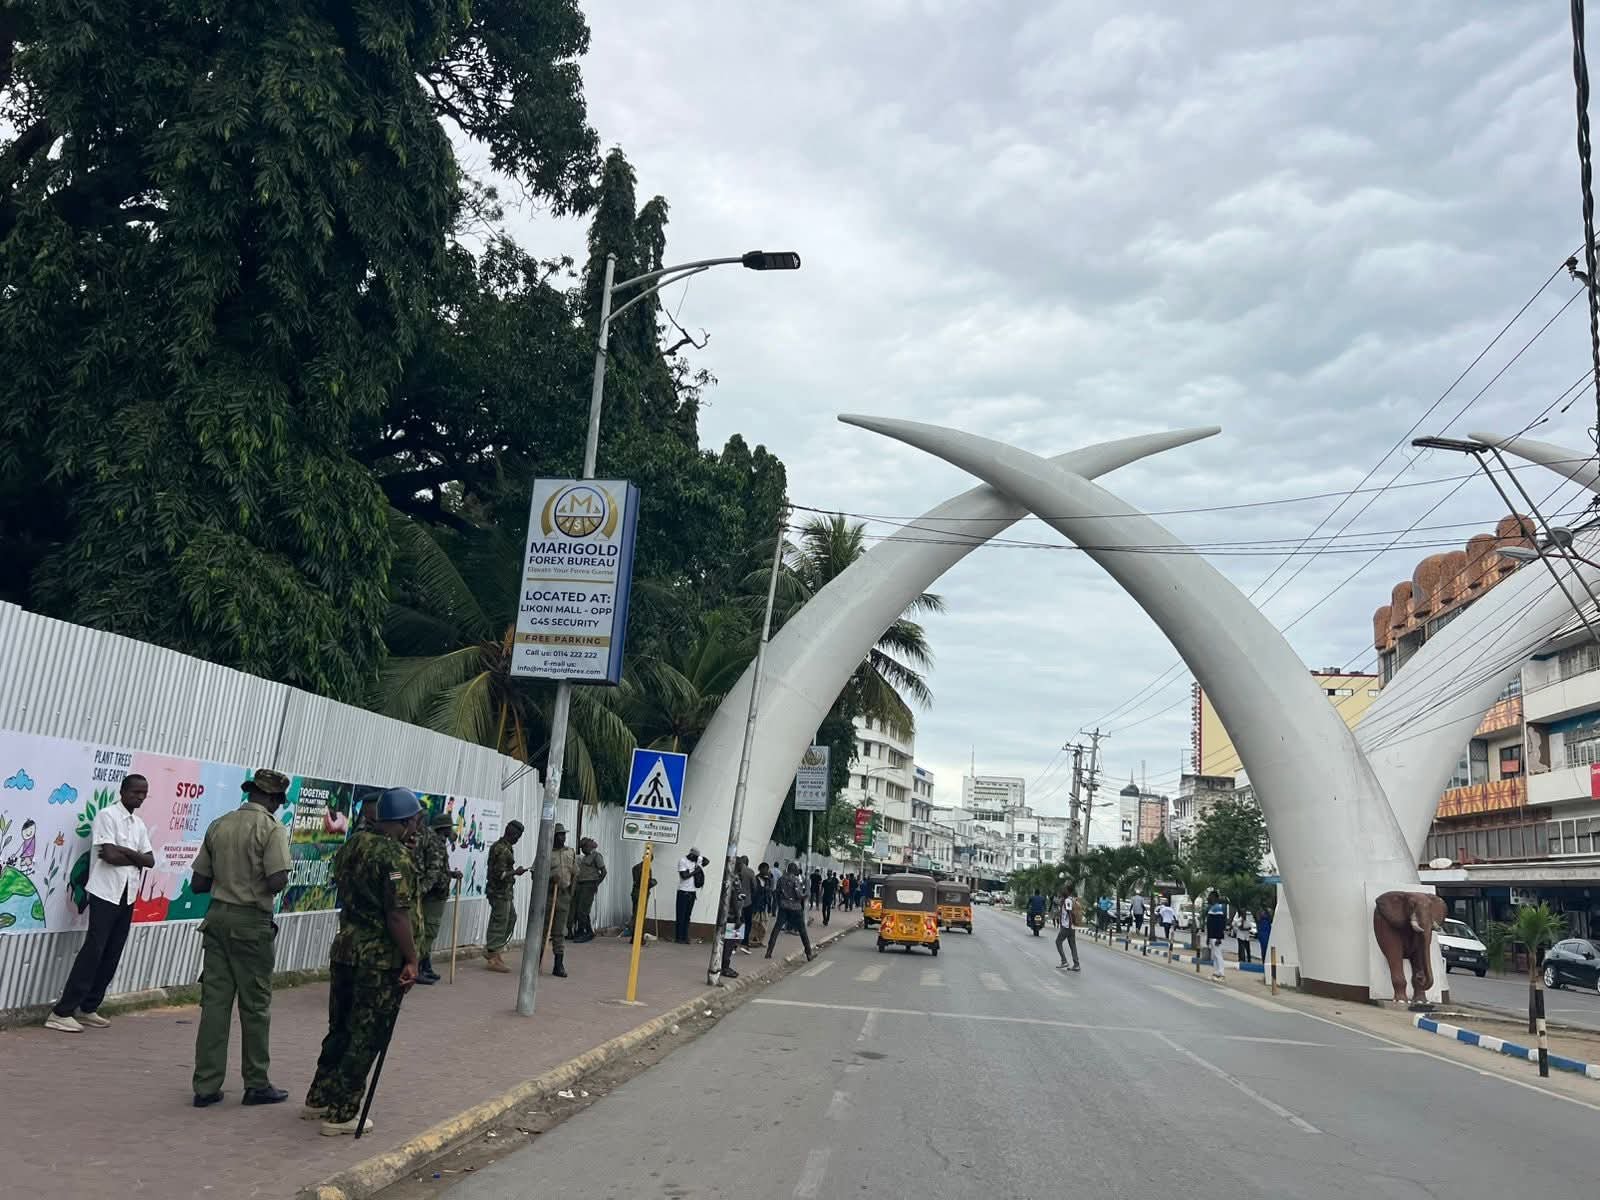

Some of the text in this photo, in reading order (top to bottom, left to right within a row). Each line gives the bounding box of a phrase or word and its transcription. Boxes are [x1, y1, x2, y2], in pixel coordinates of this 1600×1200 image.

[530, 542, 618, 556] MARIGOLD
[529, 556, 615, 567] FOREX BUREAU
[526, 591, 611, 604] LOCATED AT:
[520, 604, 553, 613] LIKONI
[556, 605, 582, 614] MALL
[590, 607, 612, 616] OPP
[530, 617, 599, 628] G4S SECURITY
[525, 634, 601, 645] FREE PARKING
[517, 665, 601, 675] info@marigoldforex.com
[94, 750, 132, 767] PLANT TREES
[92, 767, 108, 781] SAVE
[176, 782, 204, 798] STOP
[300, 787, 330, 799] TOGETHER
[171, 802, 201, 816] CLIMATE
[169, 816, 199, 832] CHANGE
[295, 815, 323, 830] EARTH
